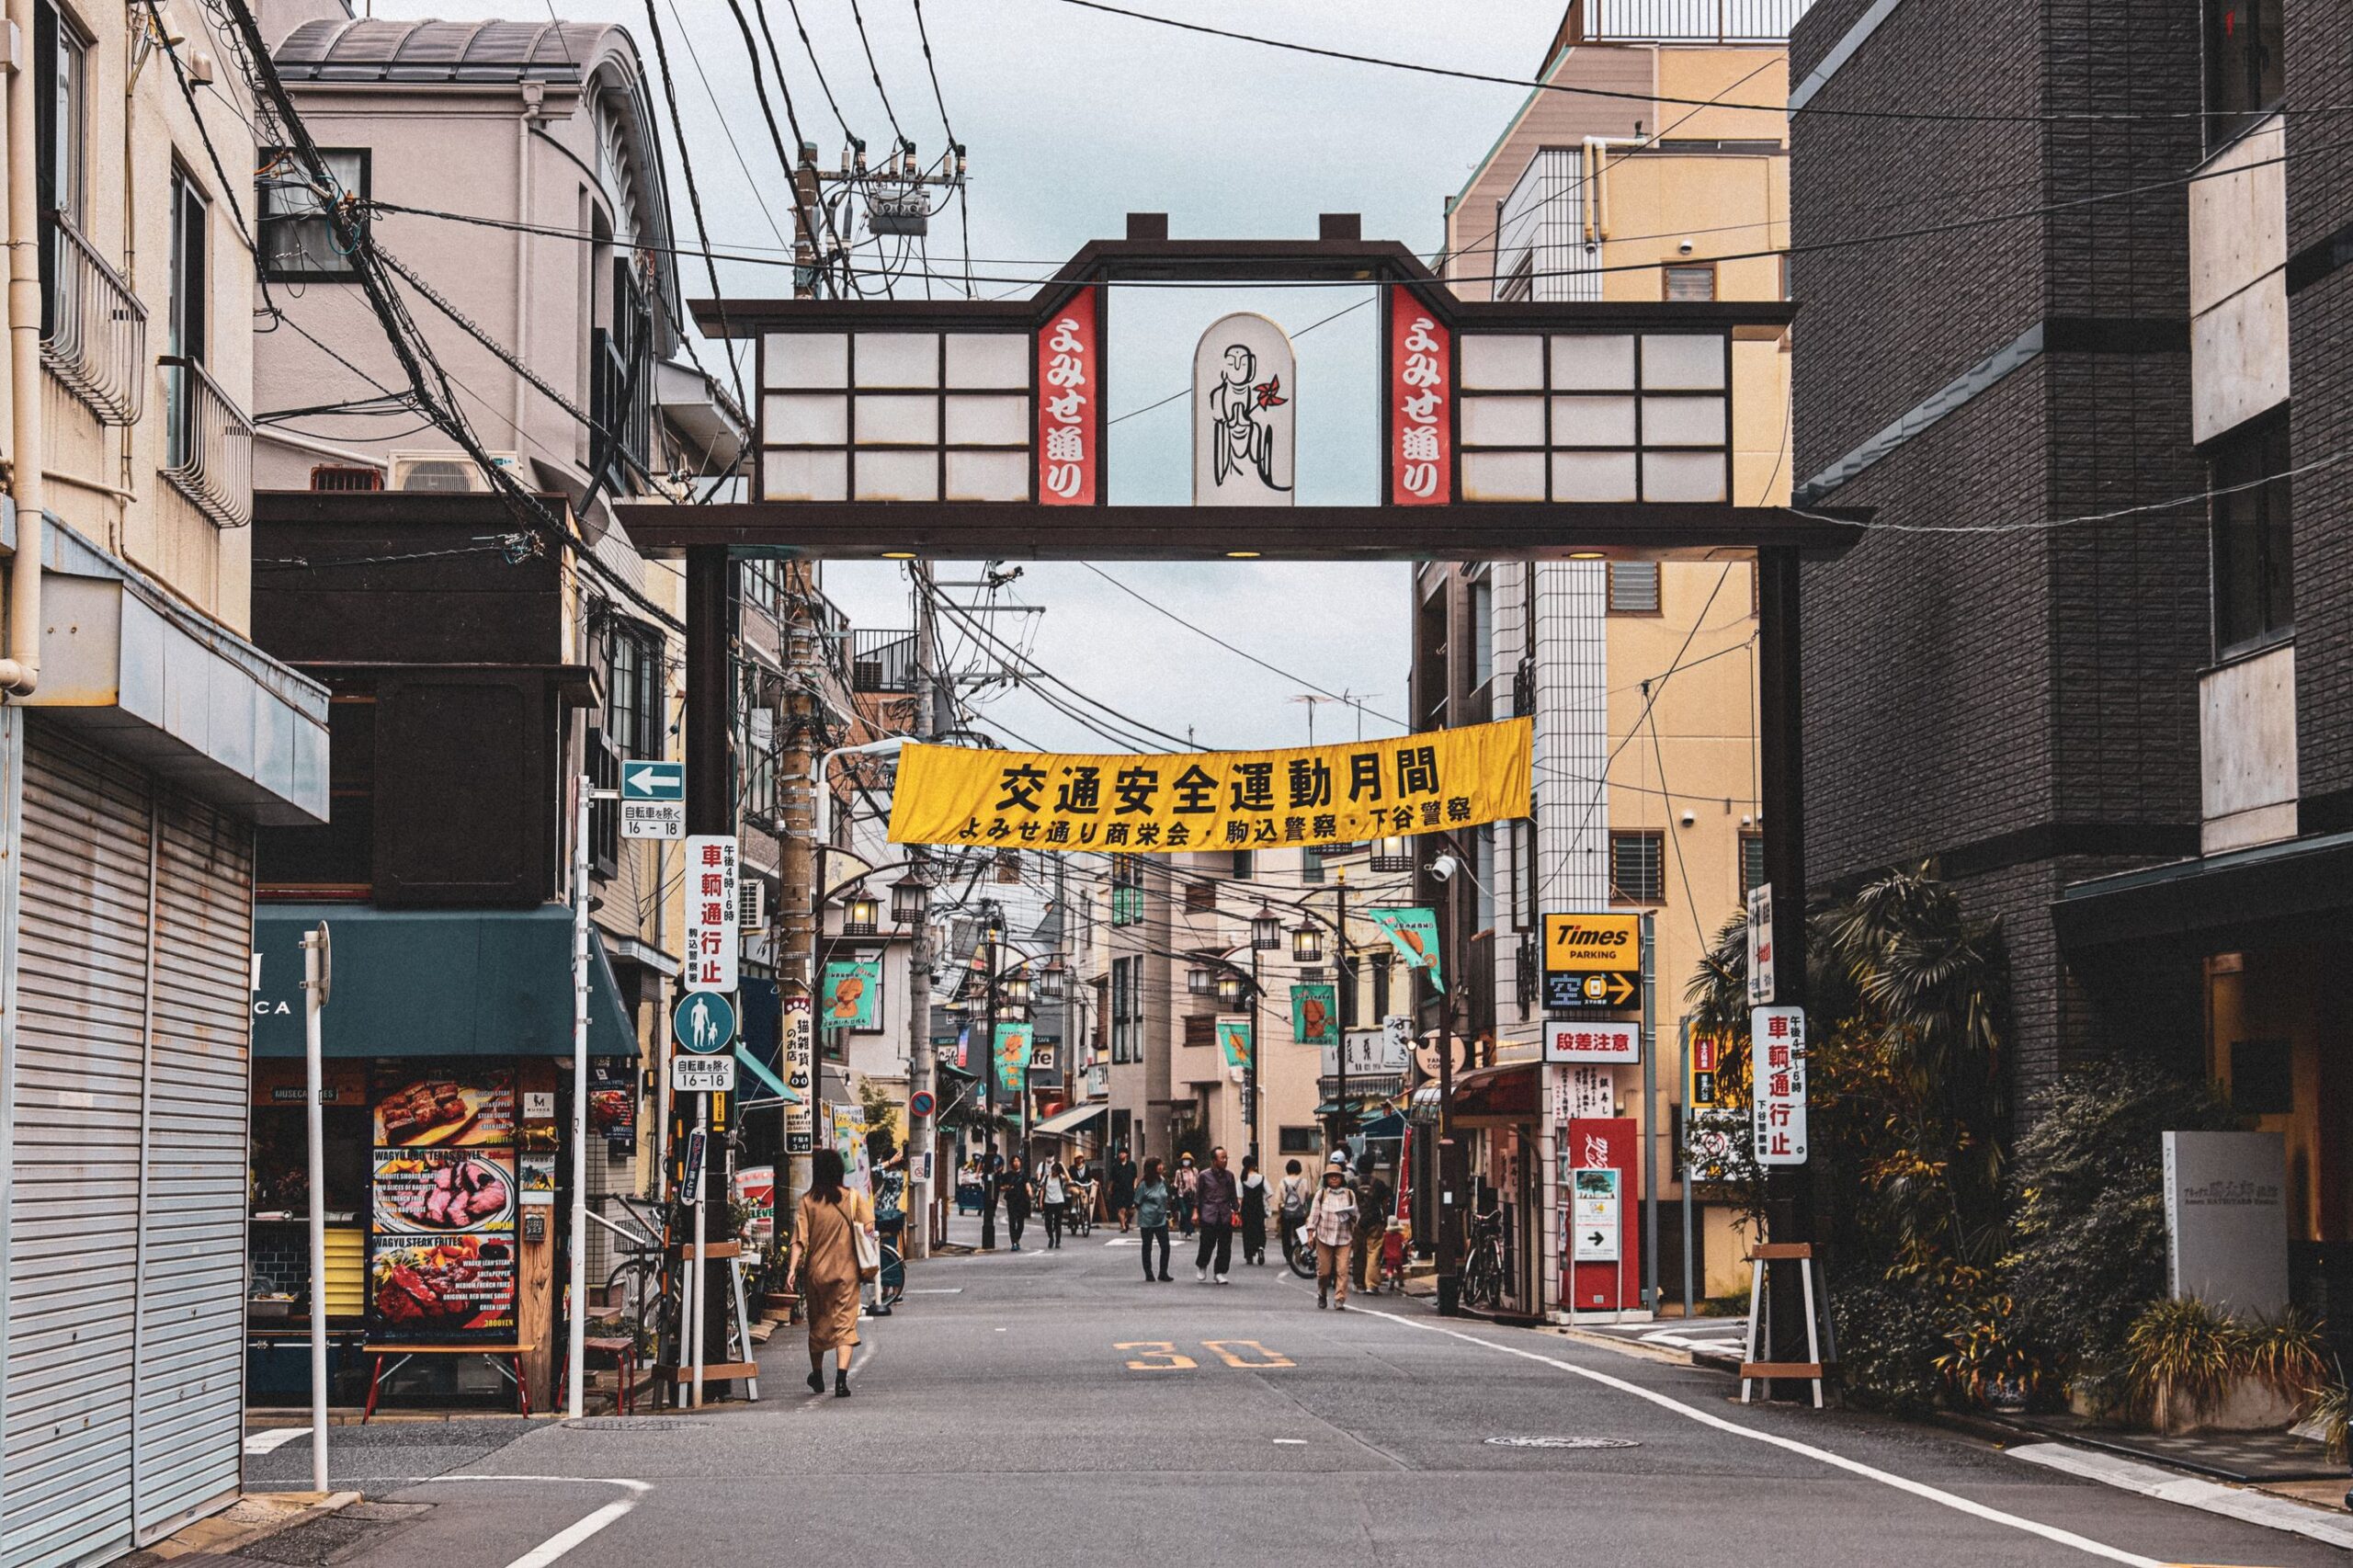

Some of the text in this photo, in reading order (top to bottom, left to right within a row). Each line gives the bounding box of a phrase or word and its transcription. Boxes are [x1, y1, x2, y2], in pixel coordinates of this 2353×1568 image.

[1046, 318, 1086, 498] よみせ通り
[1402, 317, 1440, 498] よみせ通り
[995, 745, 1441, 815] 交通安全運動月間
[625, 806, 681, 819] 自転車を除く
[629, 822, 641, 834] 16
[665, 823, 677, 835] 18
[1557, 925, 1630, 945] Times
[688, 928, 698, 983] 駒込警察署
[1570, 950, 1617, 960] PARKING
[1550, 974, 1582, 1006] 空
[787, 1028, 797, 1062] のお店
[798, 1019, 809, 1066] 猫雑貨
[1556, 1032, 1630, 1051] 段差注意
[677, 1060, 729, 1074] 自転車を除く
[1757, 1100, 1767, 1154] 下谷警察署
[374, 1151, 405, 1161] WAGYU
[374, 1237, 462, 1247] WAGYU STEAK FRITES
[485, 1319, 514, 1327] 3800YEN
[1112, 1340, 1297, 1369] 30
